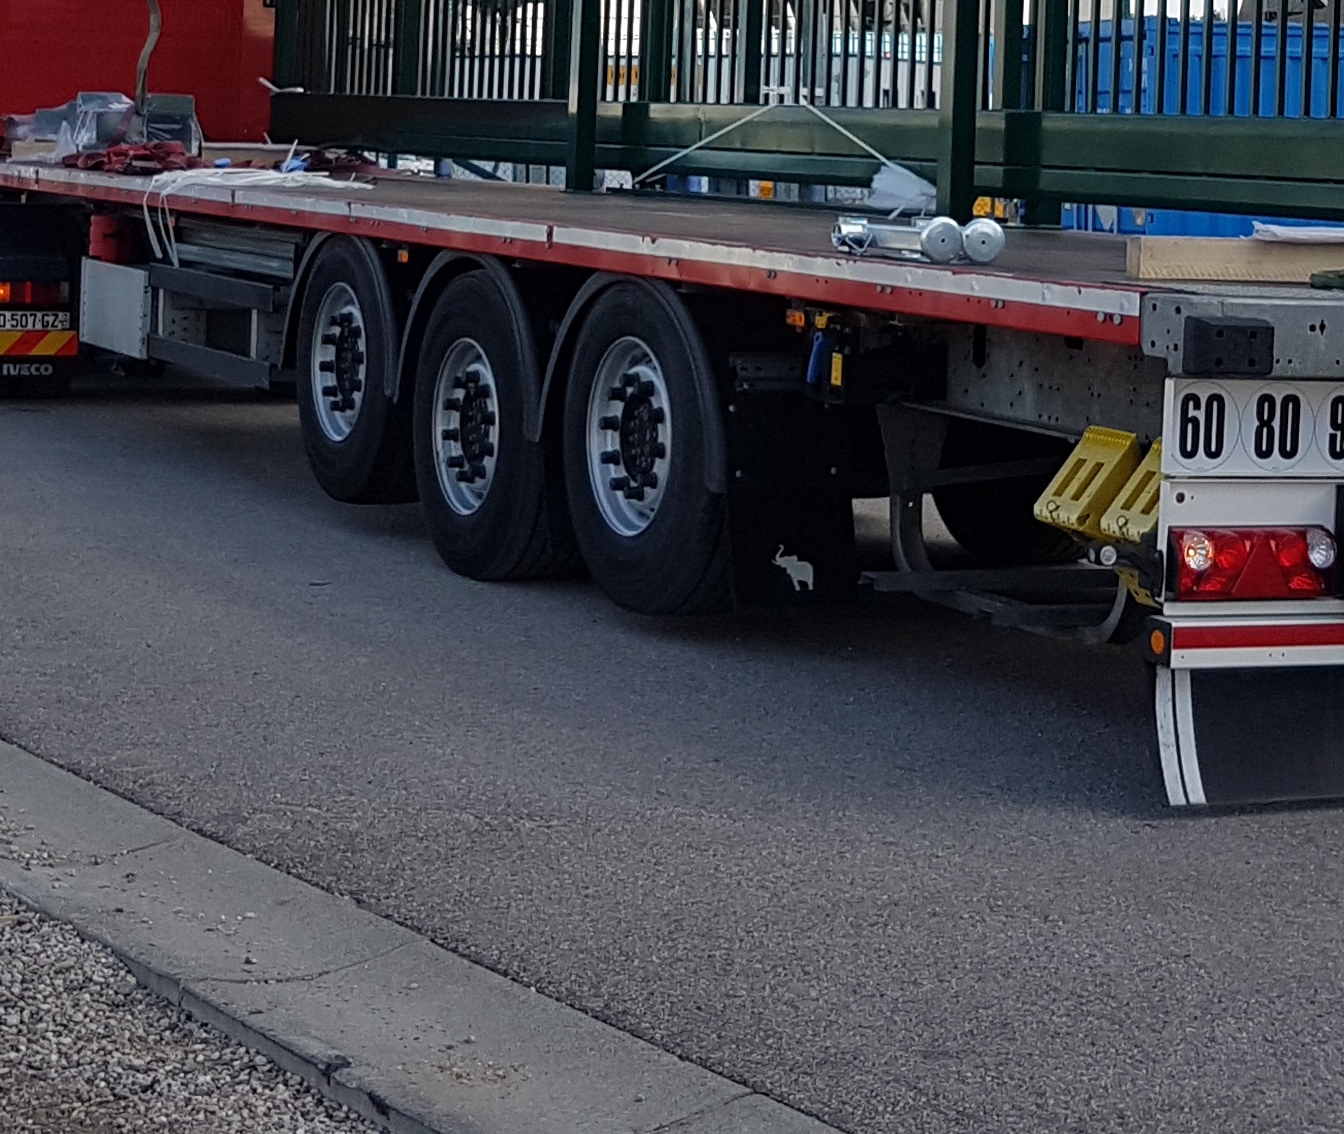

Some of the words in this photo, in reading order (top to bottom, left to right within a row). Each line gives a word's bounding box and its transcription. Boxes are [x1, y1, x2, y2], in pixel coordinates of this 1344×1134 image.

[2, 363, 54, 376] IVECO
[1179, 392, 1225, 459] 60
[1254, 393, 1301, 459] 80
